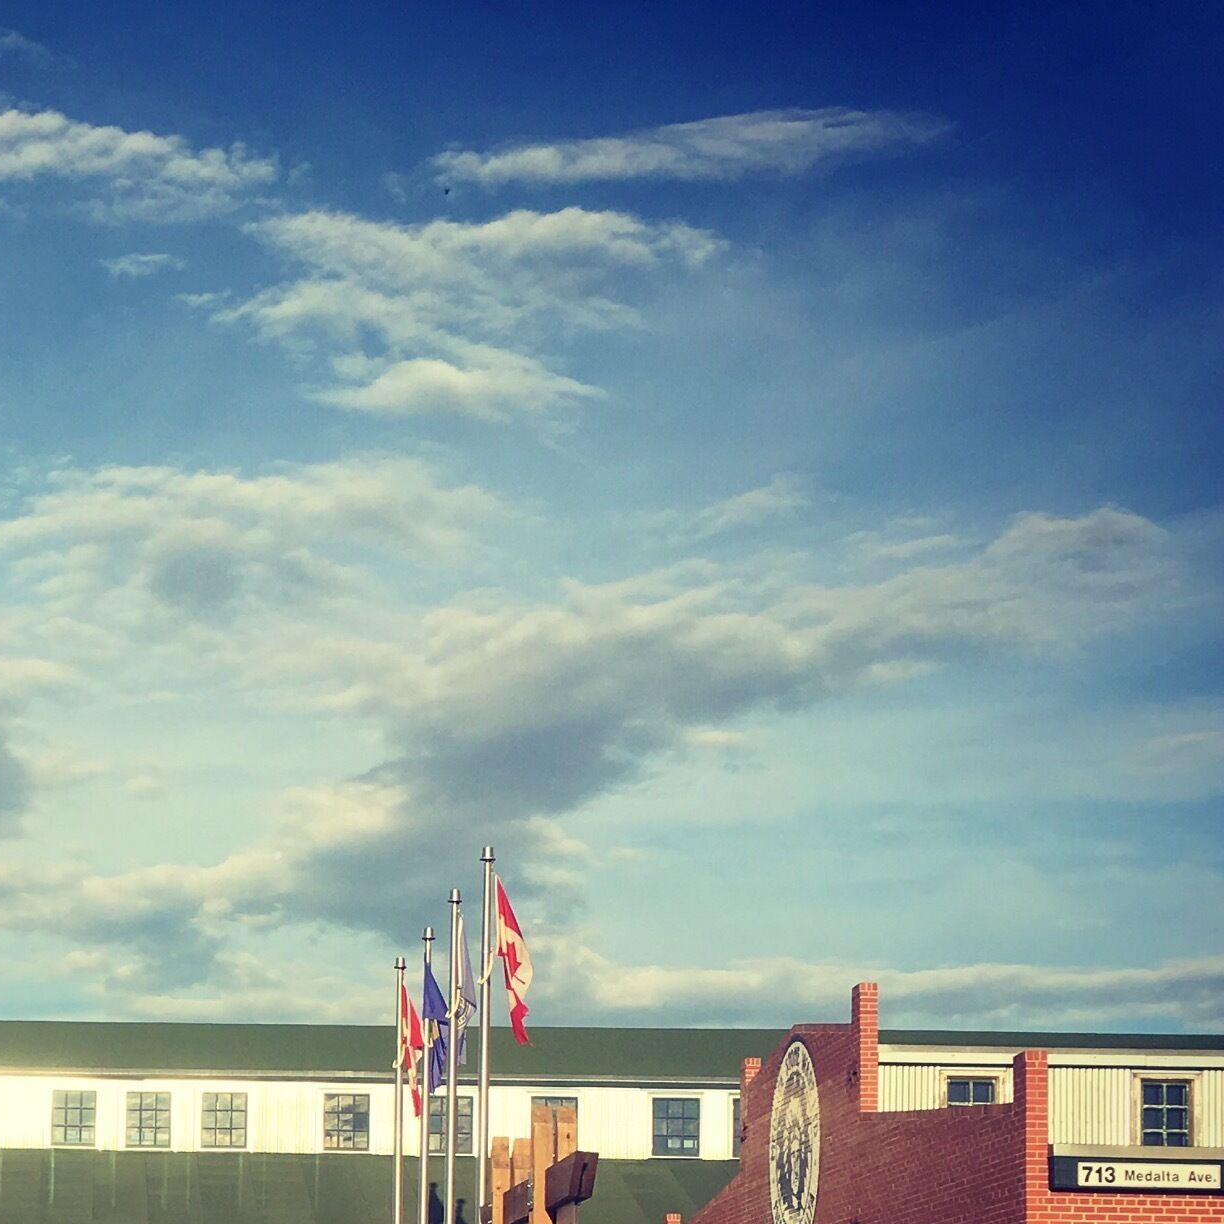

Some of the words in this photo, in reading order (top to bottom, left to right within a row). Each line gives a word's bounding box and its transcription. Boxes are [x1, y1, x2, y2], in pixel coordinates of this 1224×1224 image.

[1082, 1166, 1116, 1183] 713
[1124, 1170, 1180, 1182] Medalta
[1188, 1171, 1217, 1183] Ave.
